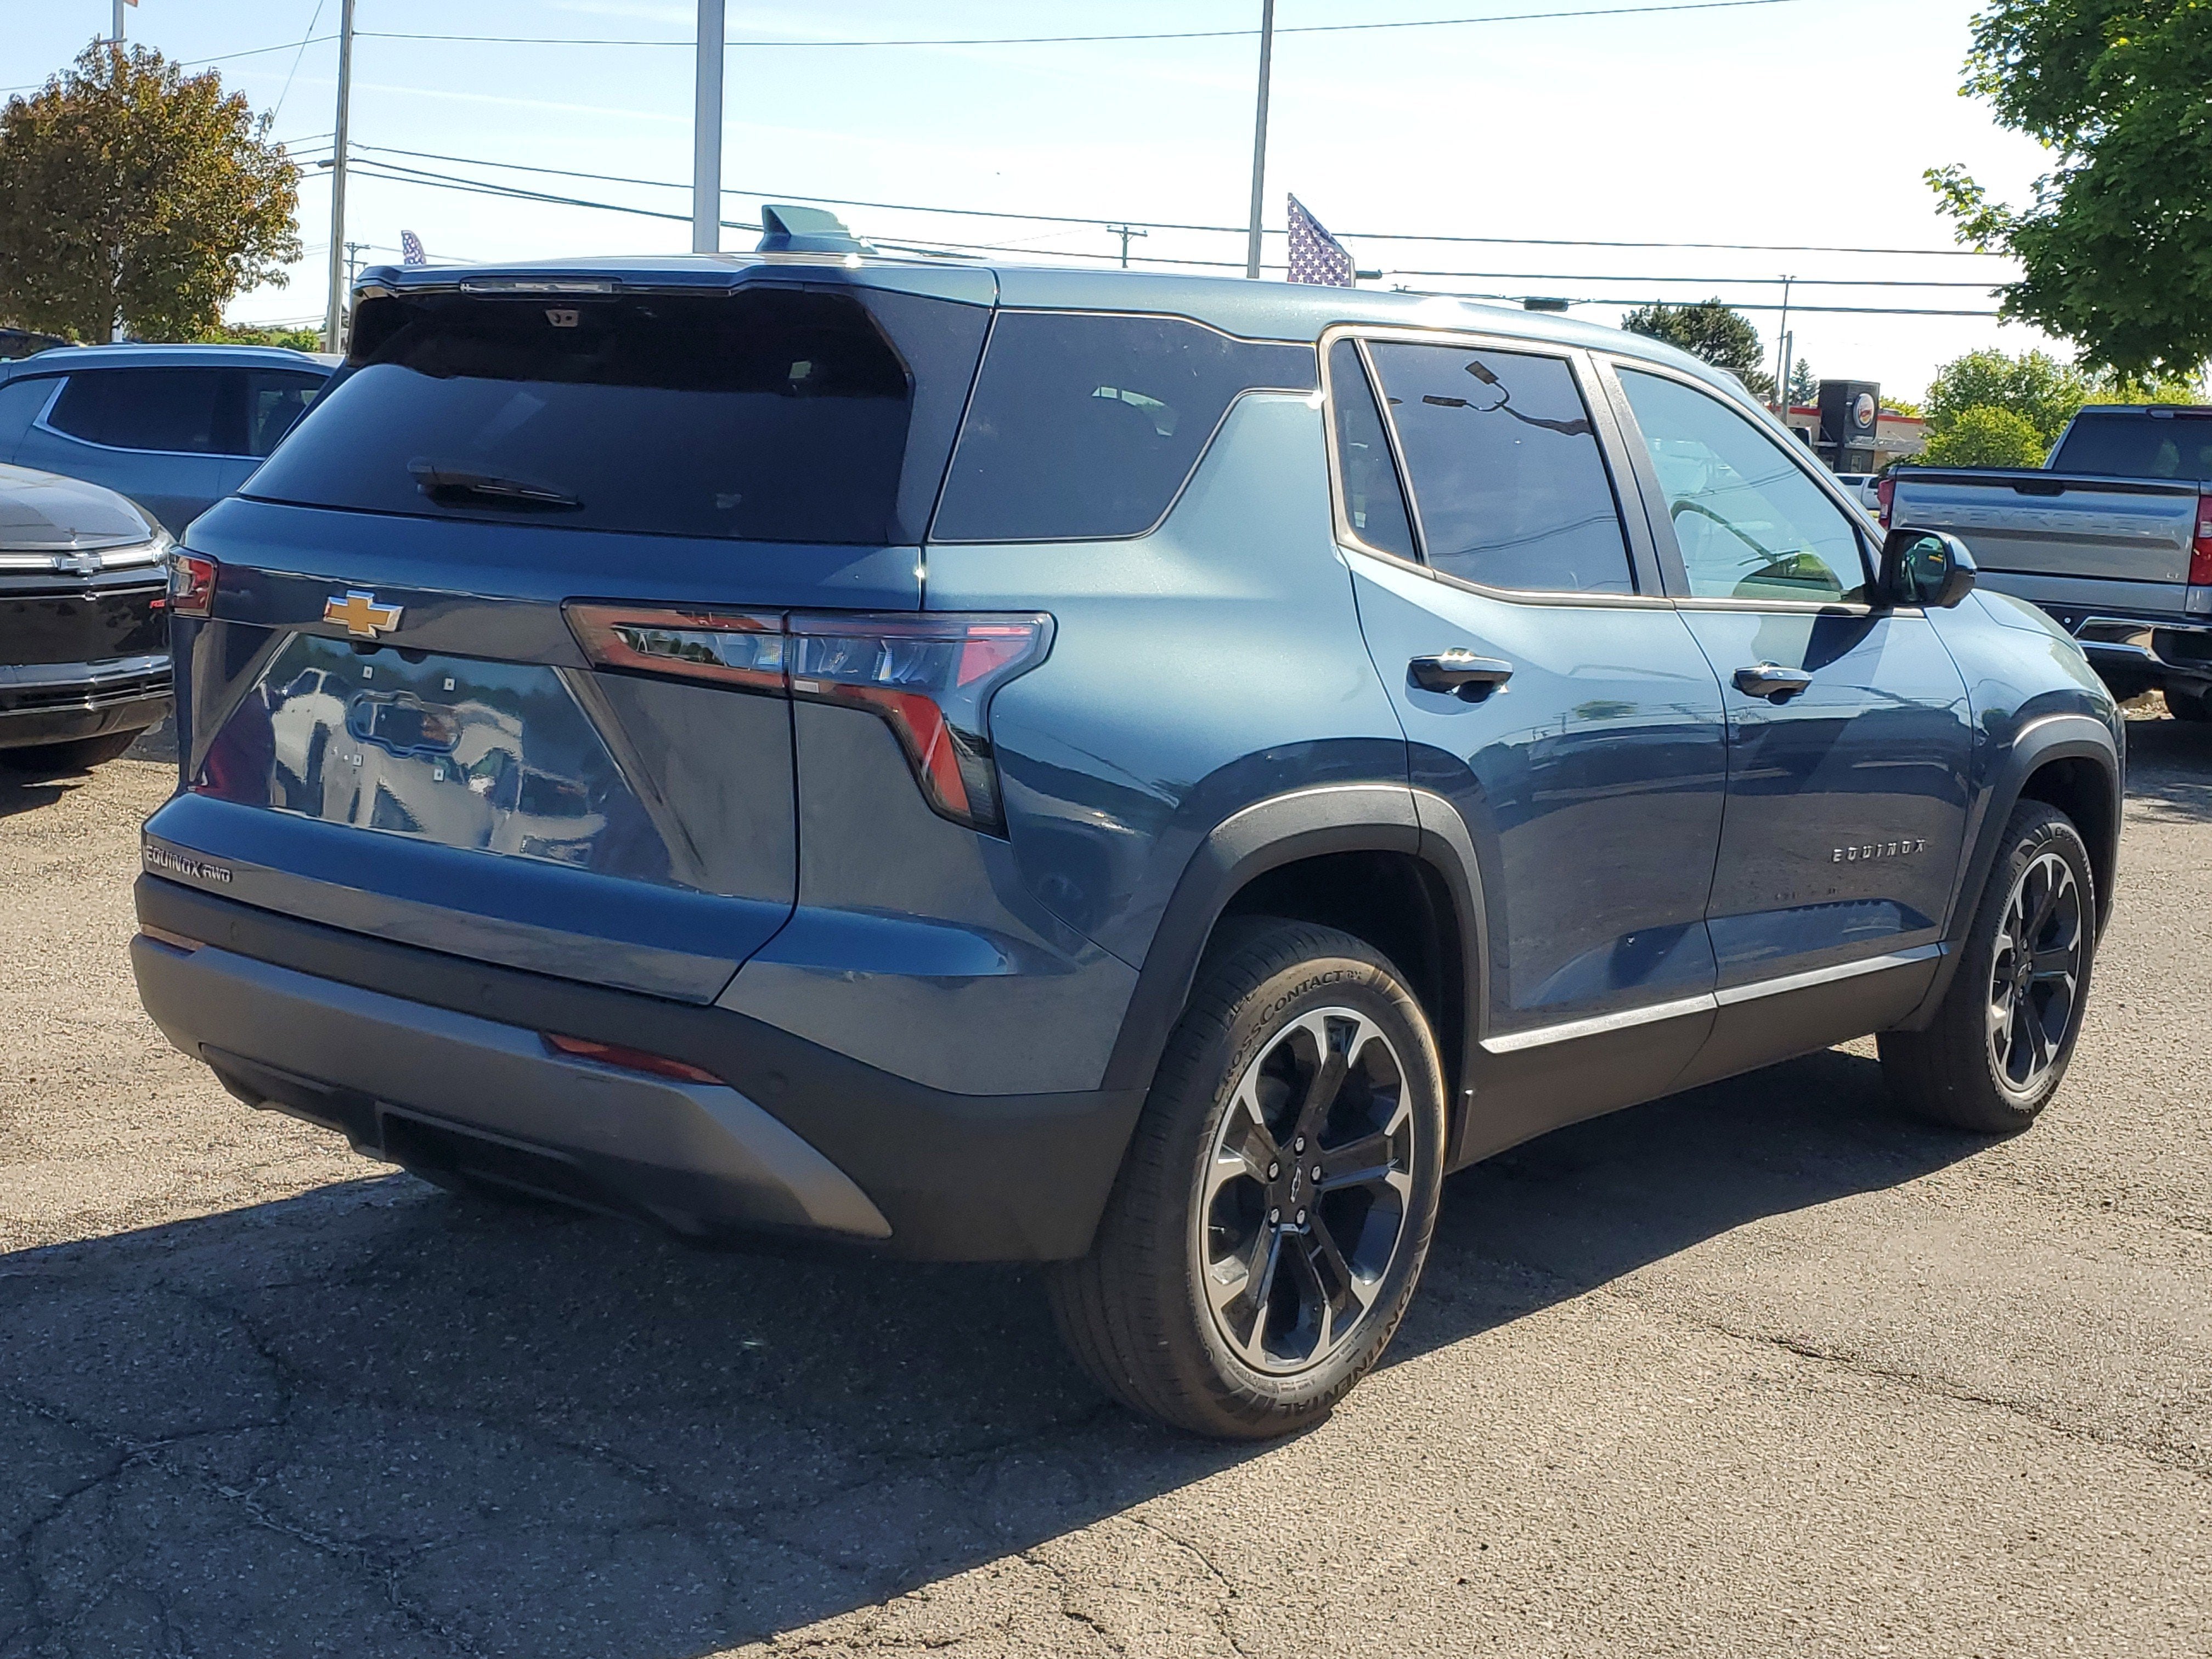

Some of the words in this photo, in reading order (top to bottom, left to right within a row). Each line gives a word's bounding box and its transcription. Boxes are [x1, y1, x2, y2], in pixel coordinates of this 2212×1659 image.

[146, 844, 202, 878] EQUINOX
[202, 864, 232, 883] AWD
[1831, 839, 1926, 864] EQUINOX
